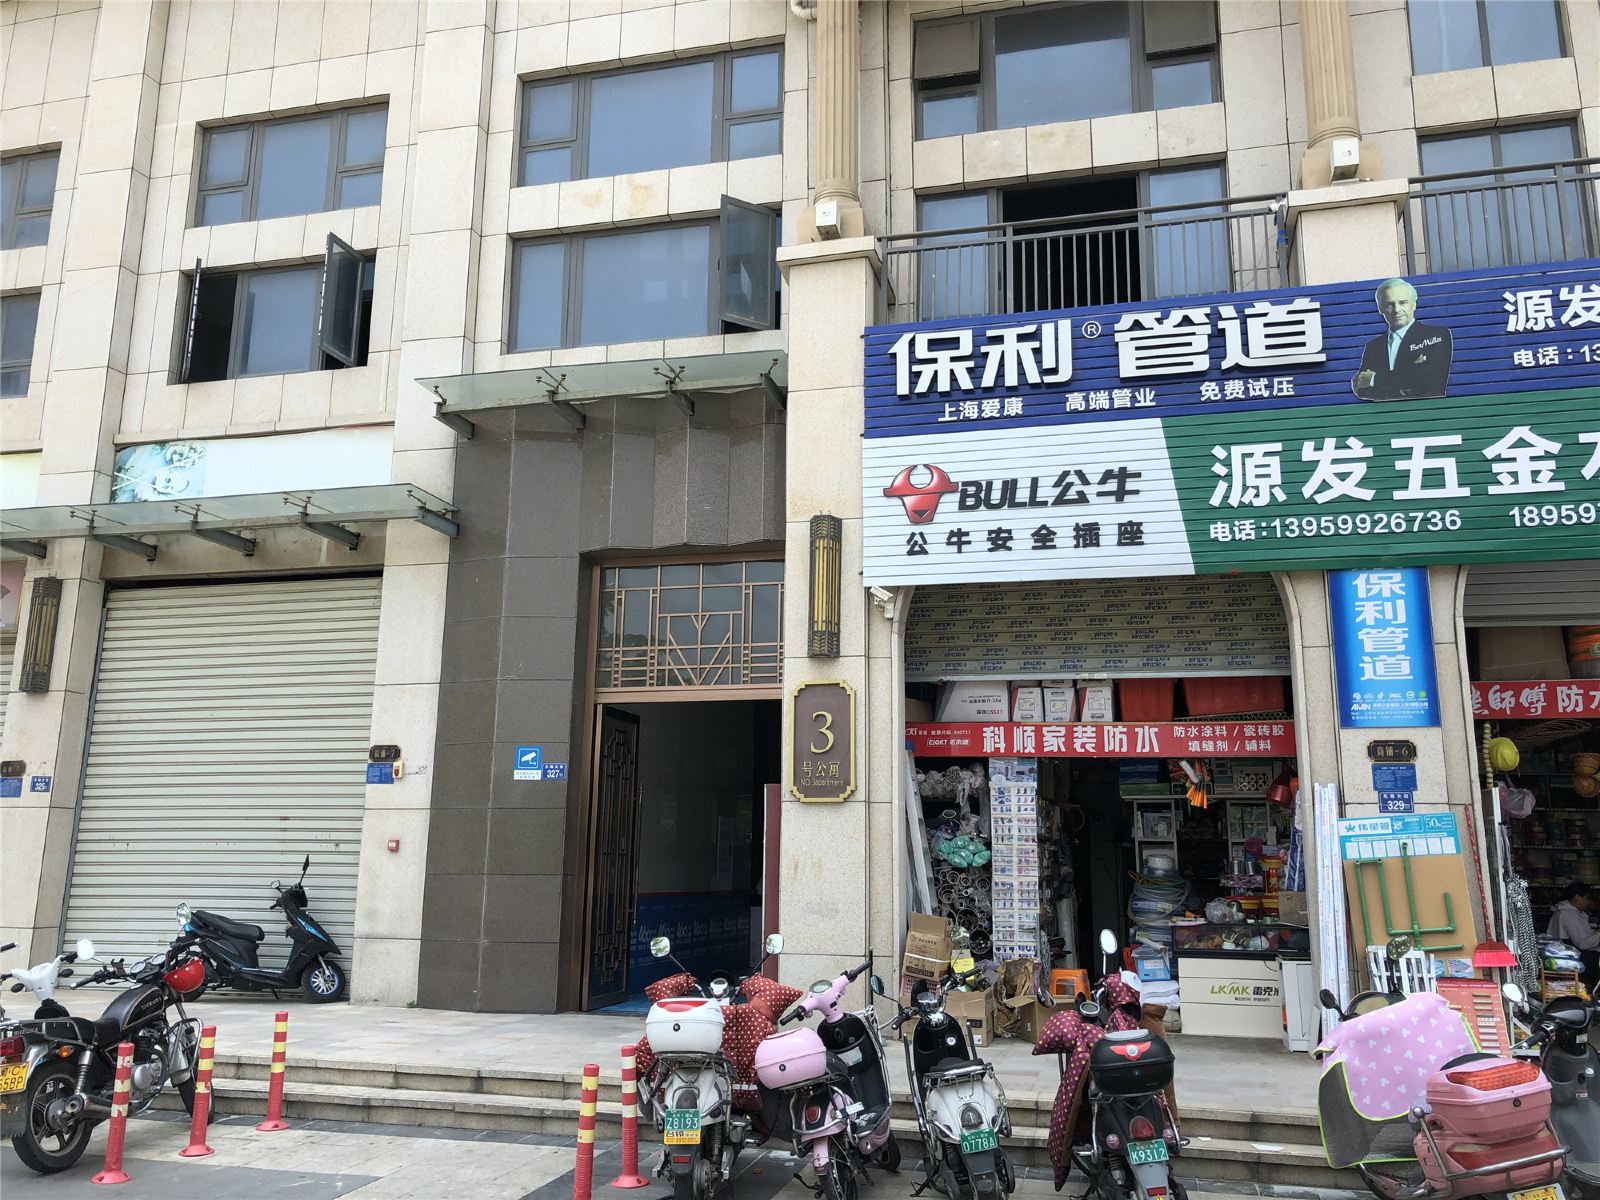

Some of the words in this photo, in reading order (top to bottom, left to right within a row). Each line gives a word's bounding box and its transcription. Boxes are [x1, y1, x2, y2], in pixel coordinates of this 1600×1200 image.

[1502, 284, 1600, 332] 源发
[887, 318, 1073, 397] 保利
[1114, 297, 1327, 379] 管道
[937, 396, 1025, 423] 上海爱康
[1065, 387, 1157, 412] 高端管业
[1199, 376, 1295, 402] 免费试压
[1509, 502, 1600, 527] 18959
[906, 520, 1146, 556] 公牛安全插座
[1352, 573, 1413, 681] 保利管道
[810, 711, 835, 754] 3
[982, 725, 1160, 754] 科顺家装防水
[1173, 725, 1227, 738] 防水涂料
[1243, 724, 1285, 737] 瓷砖胶
[1187, 739, 1228, 752] 填缝剂
[1244, 739, 1272, 752] 辅料
[802, 761, 840, 778] 号公寓
